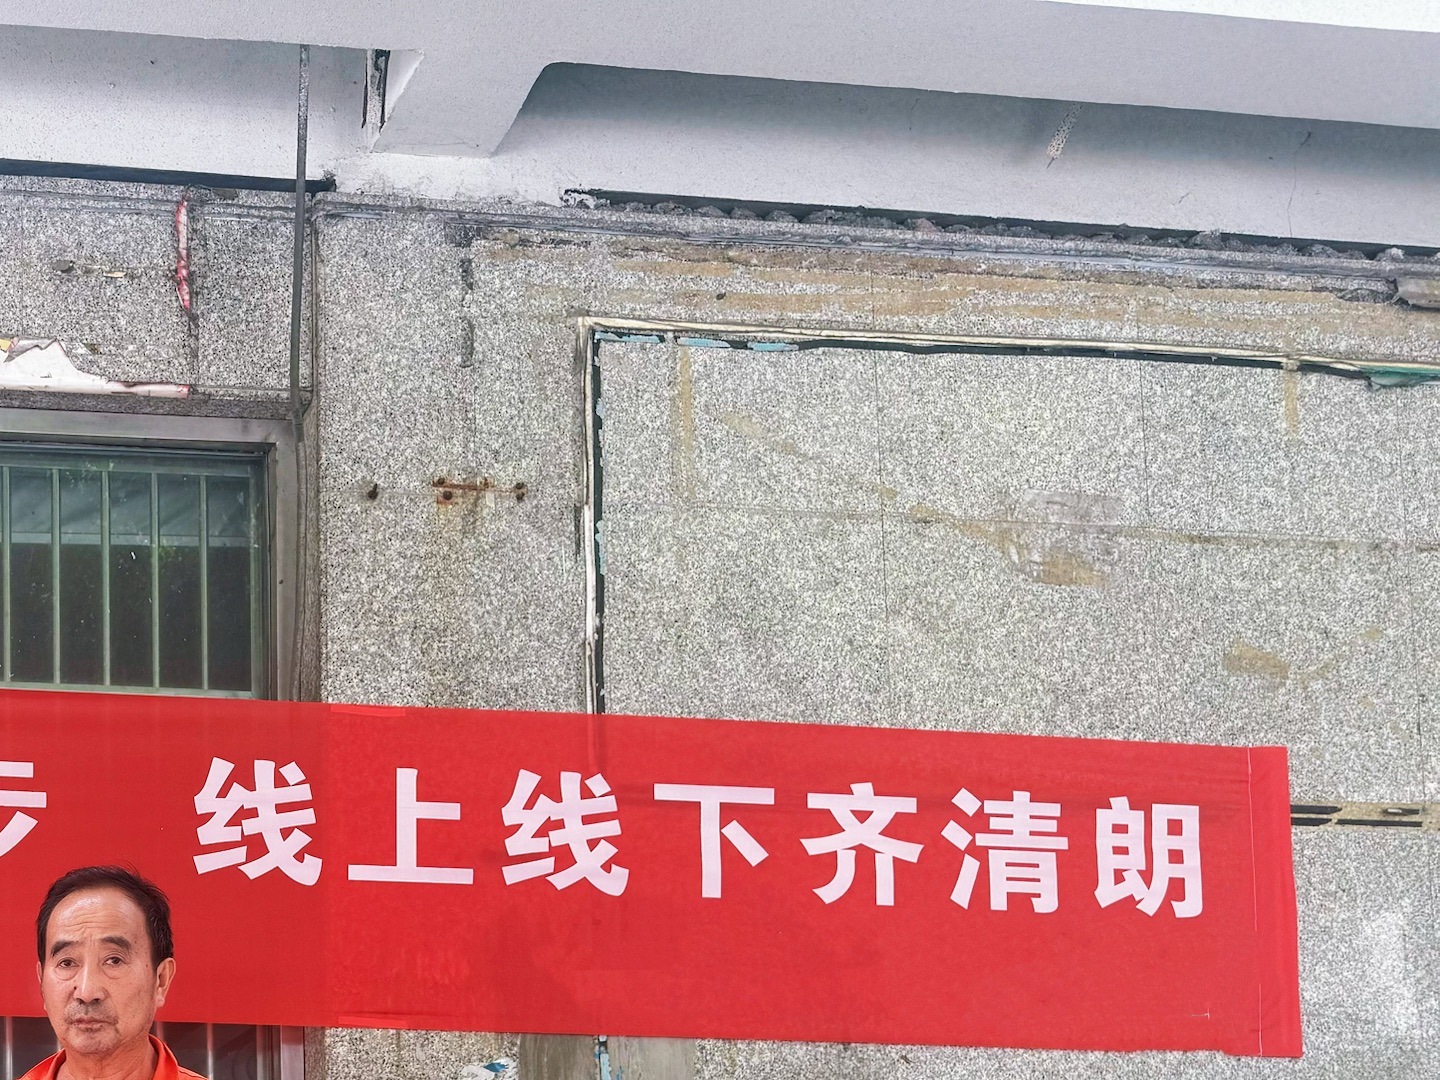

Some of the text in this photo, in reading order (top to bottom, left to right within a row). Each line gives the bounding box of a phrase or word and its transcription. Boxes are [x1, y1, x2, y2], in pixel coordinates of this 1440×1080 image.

[193, 756, 1204, 919] 线上线下齐清朗
